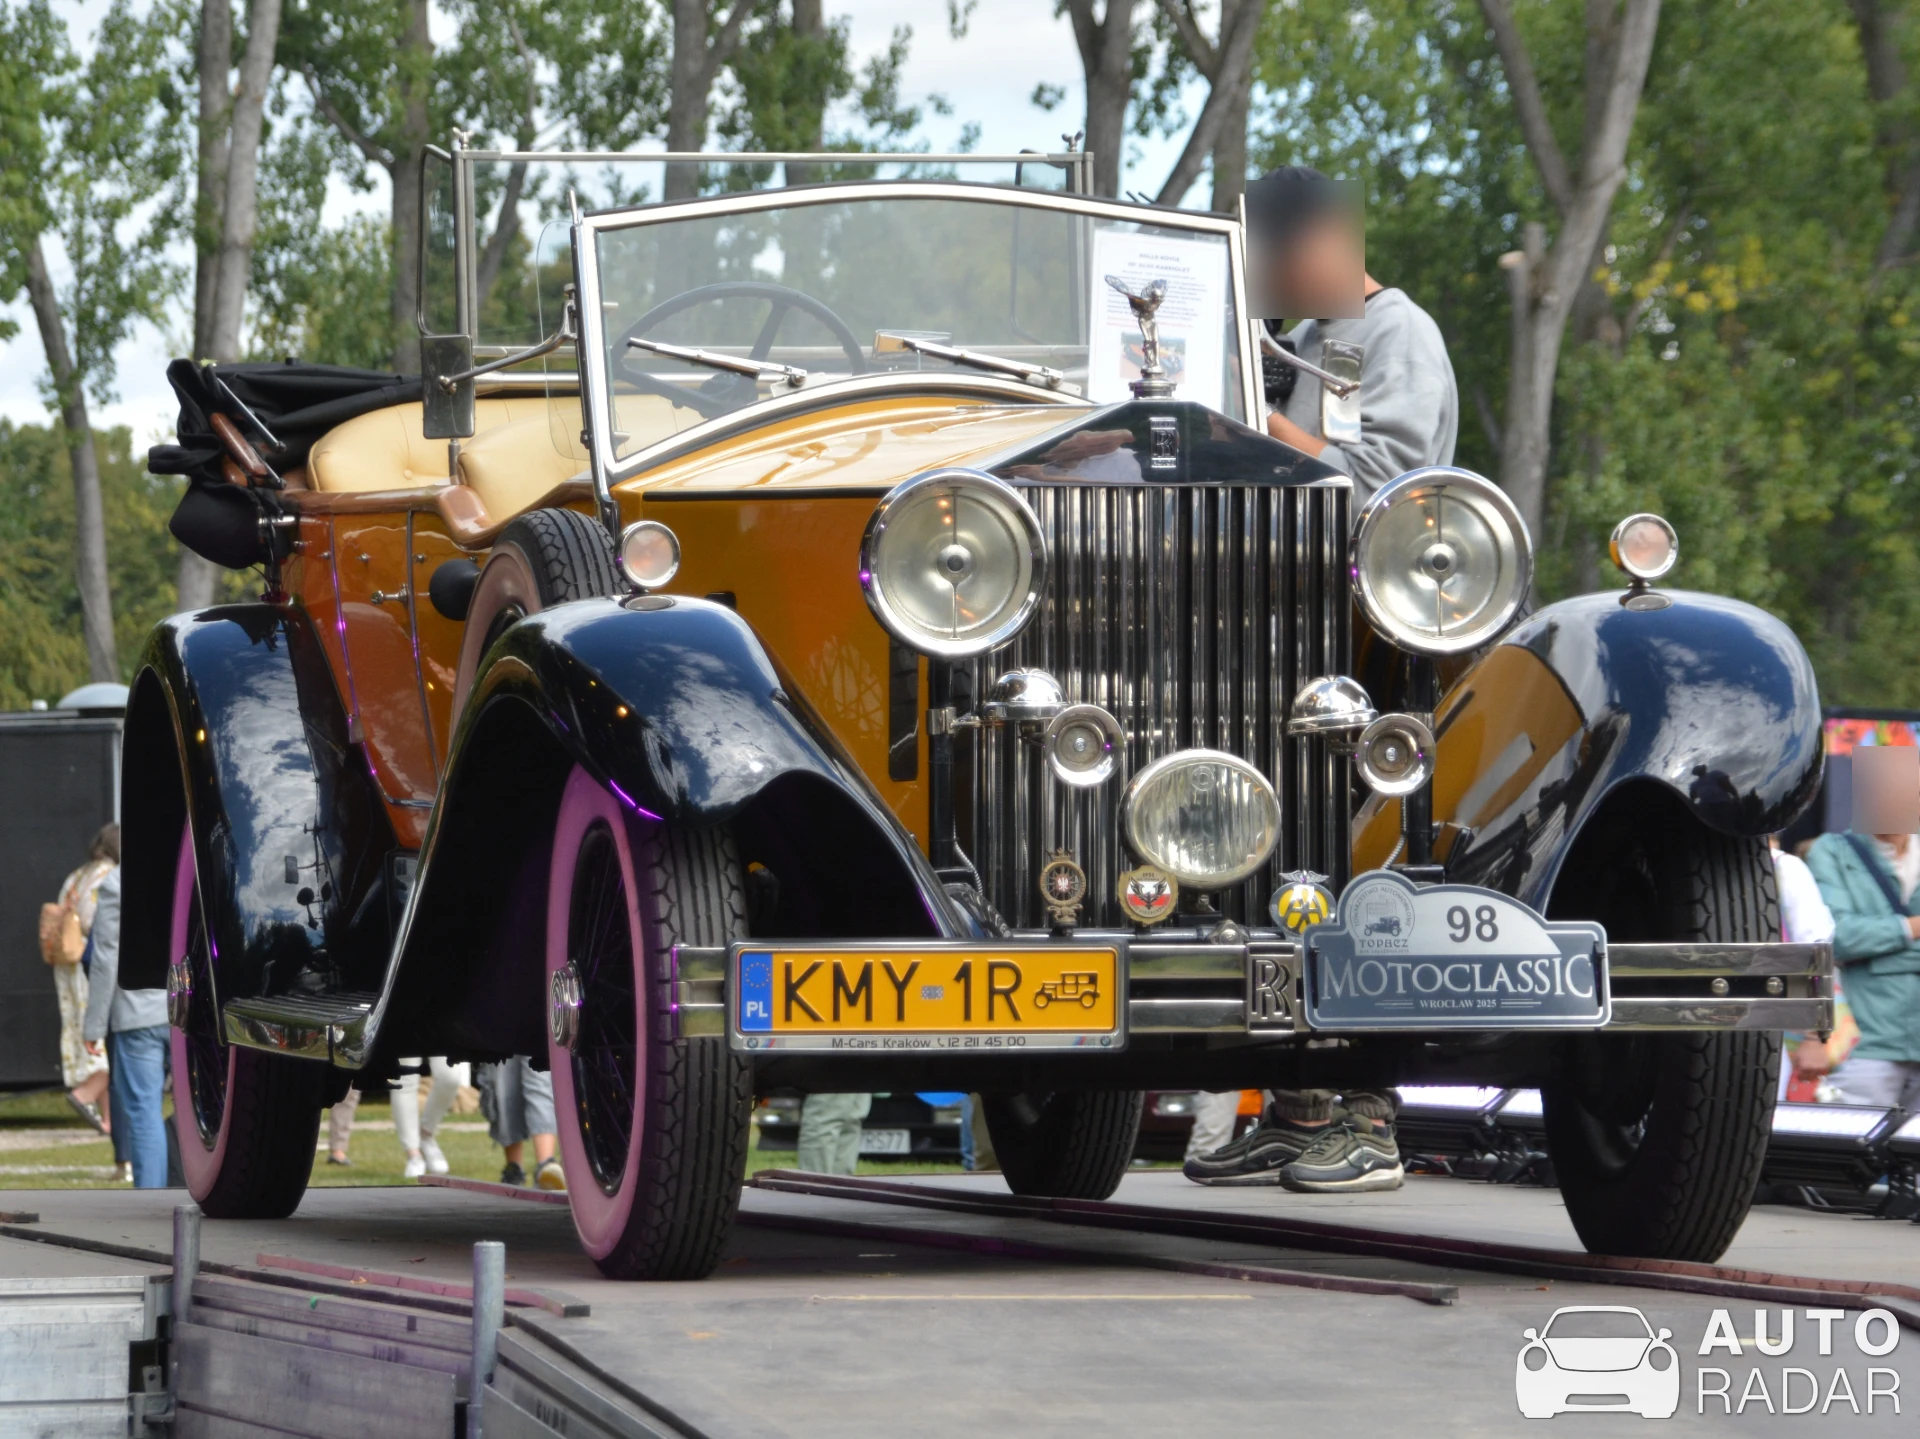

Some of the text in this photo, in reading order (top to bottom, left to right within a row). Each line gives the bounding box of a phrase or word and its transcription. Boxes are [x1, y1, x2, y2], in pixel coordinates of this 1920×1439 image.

[1446, 904, 1499, 943] 98
[783, 959, 1023, 1022] KMY 1R
[1321, 953, 1594, 1000] MOTOCLASSIC
[746, 1000, 769, 1018] PL
[1476, 999, 1497, 1008] 2025
[831, 1037, 878, 1048] M-Cars
[882, 1037, 931, 1048] Kraków
[947, 1036, 960, 1048] 12
[984, 1036, 1003, 1047] 45
[1006, 1036, 1026, 1047] 00
